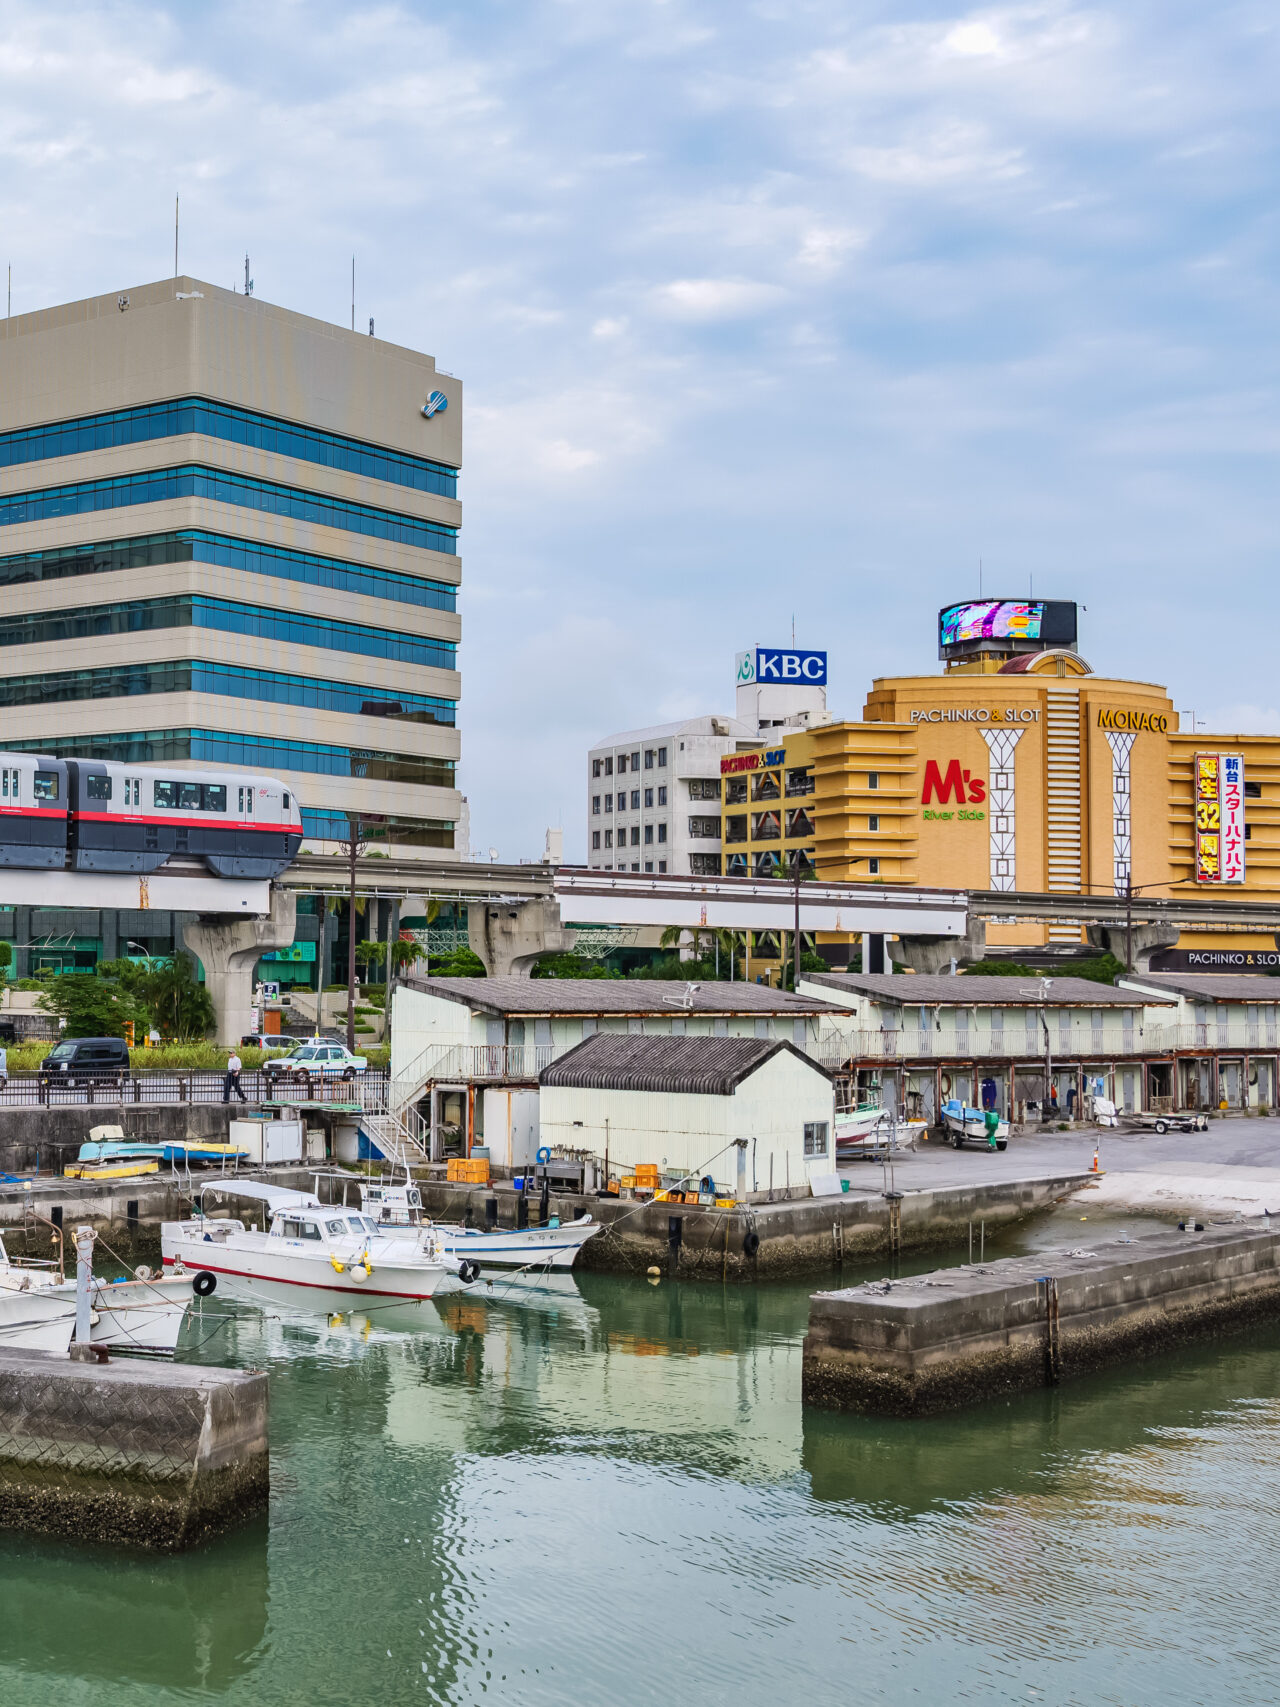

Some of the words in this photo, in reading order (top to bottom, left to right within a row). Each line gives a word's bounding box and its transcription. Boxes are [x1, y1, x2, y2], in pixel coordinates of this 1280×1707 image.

[758, 653, 824, 679] KBC
[910, 709, 990, 722] PACHINKO
[991, 709, 1003, 721] &
[1005, 709, 1041, 722] SLOT
[1097, 709, 1168, 733] MONACO
[765, 749, 787, 766] SLOT
[921, 759, 986, 804] M's
[923, 809, 955, 821] River
[958, 809, 985, 821] Side
[1225, 758, 1241, 879] 新台スターハナハナ
[1188, 953, 1245, 965] PACHINKO
[1246, 954, 1255, 965] &
